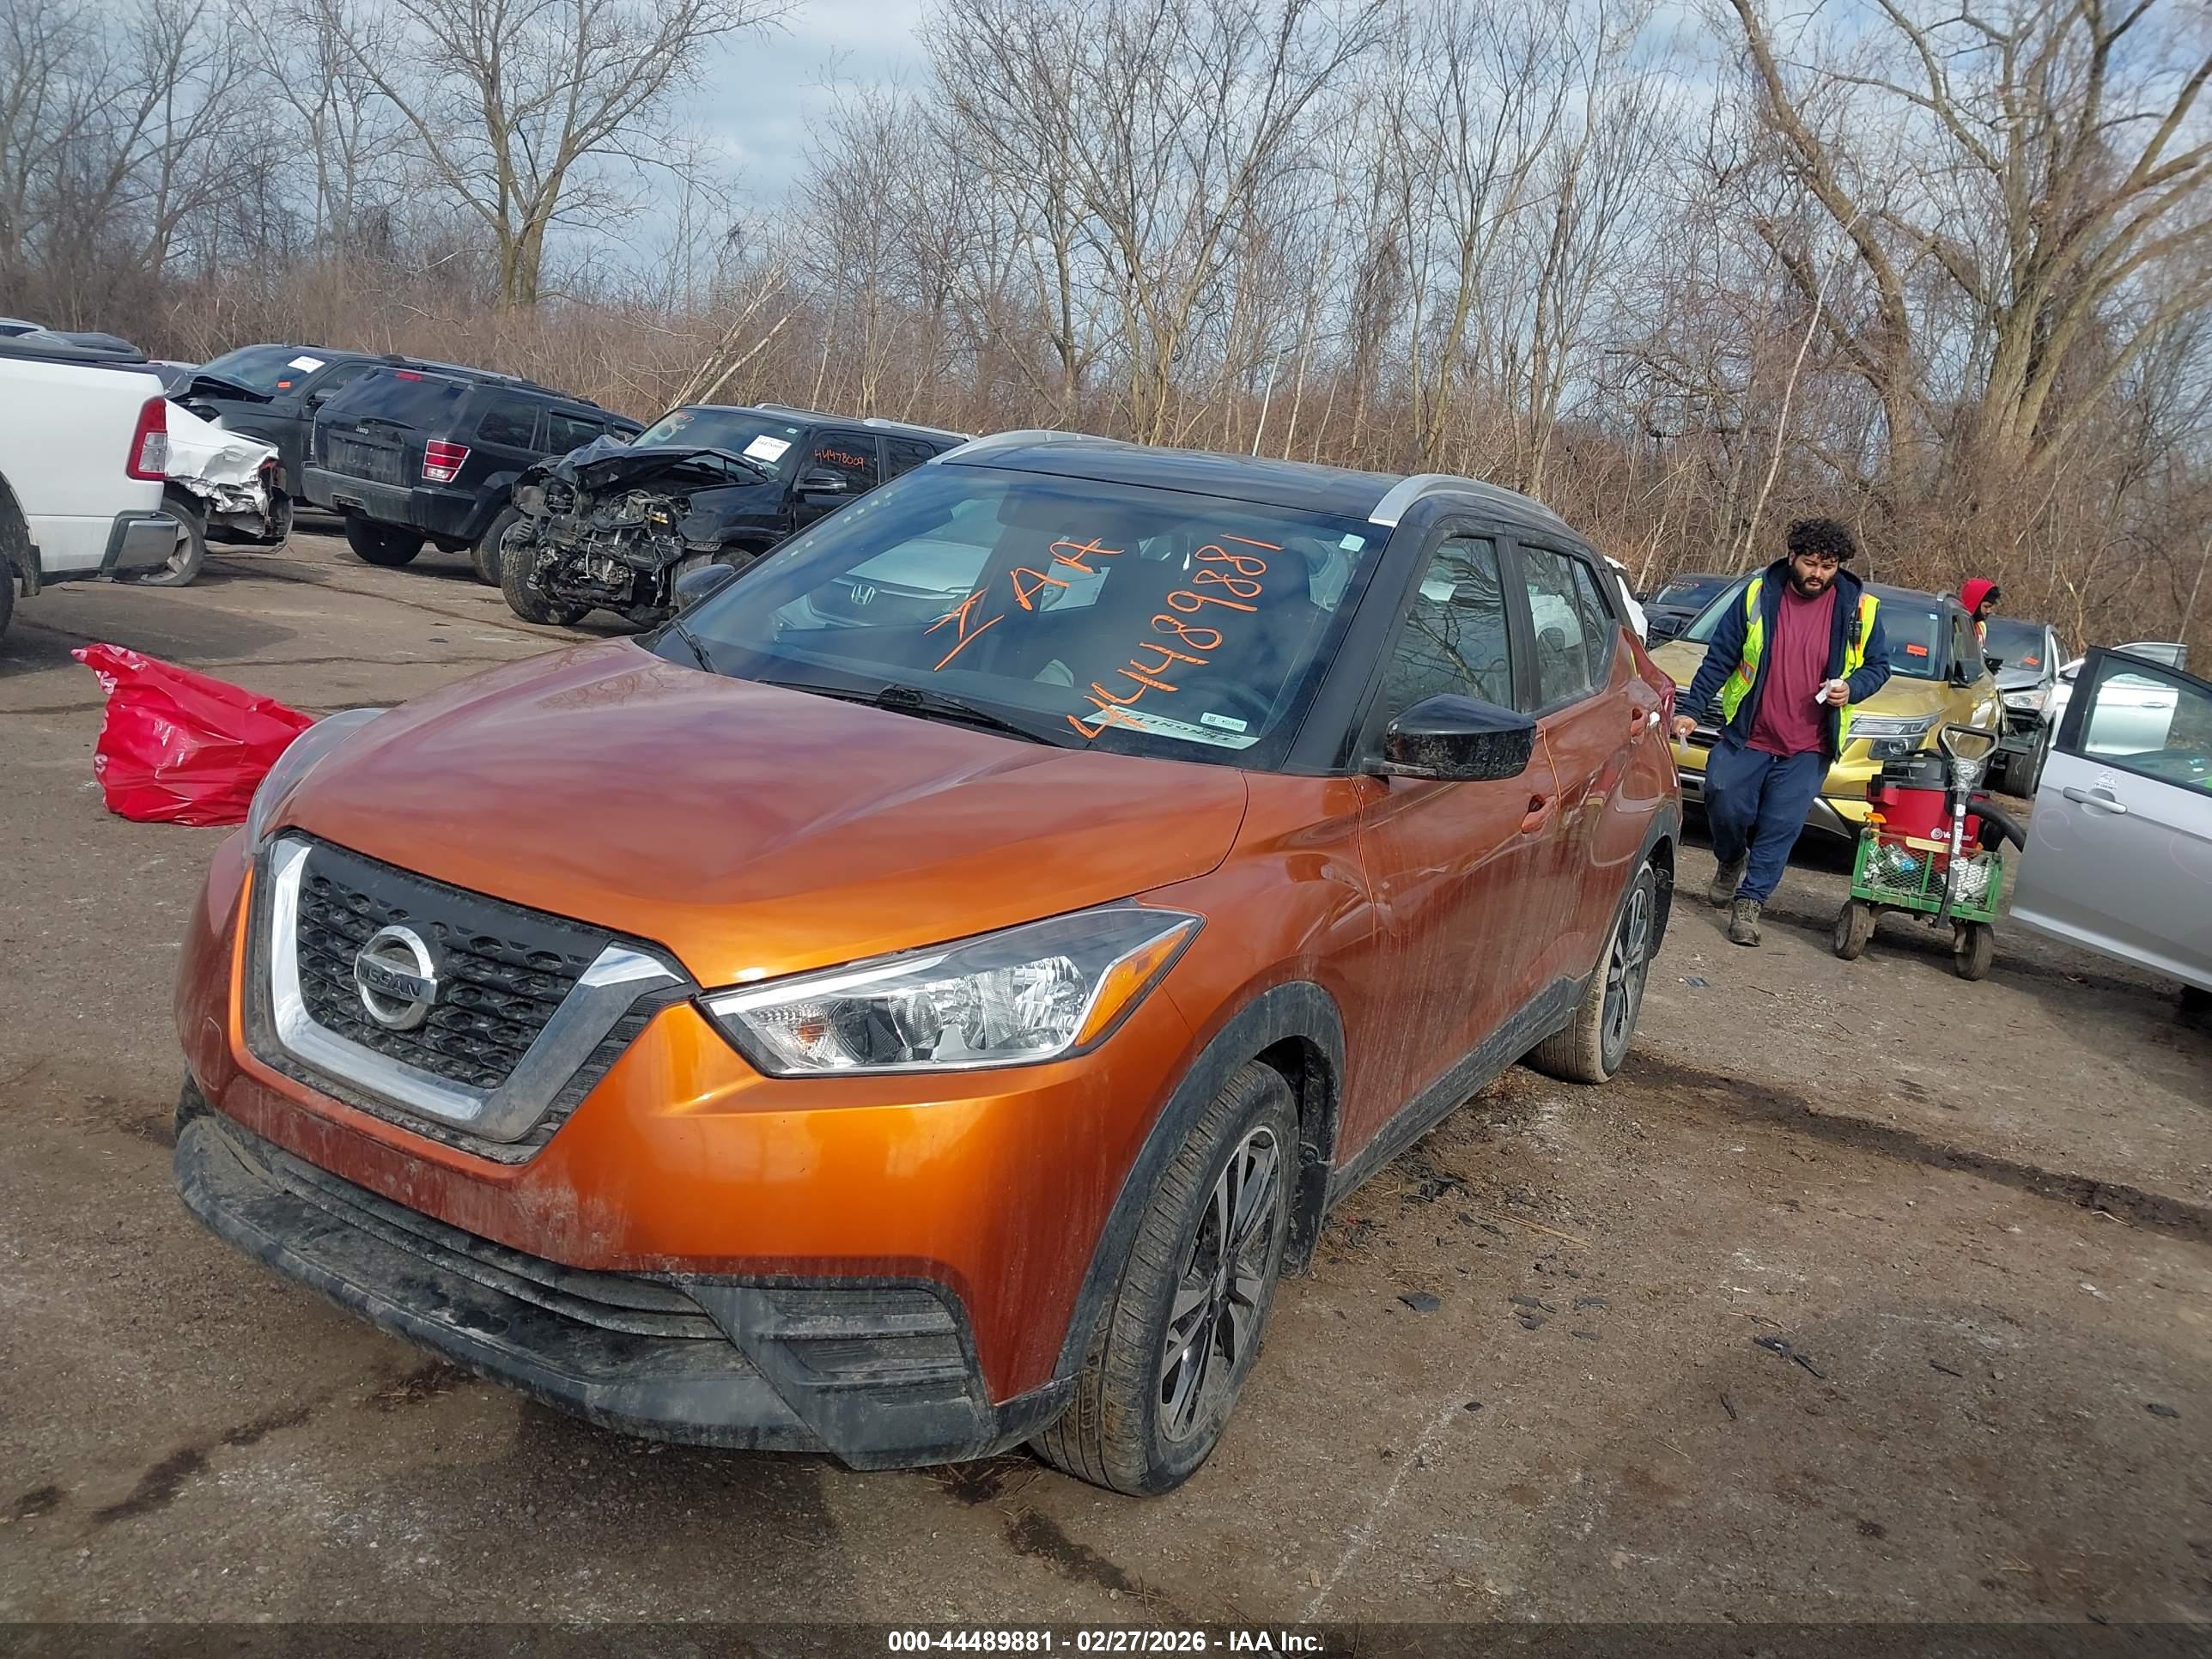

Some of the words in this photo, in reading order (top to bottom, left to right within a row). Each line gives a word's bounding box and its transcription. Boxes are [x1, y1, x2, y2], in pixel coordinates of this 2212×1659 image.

[814, 448, 865, 471] 44478009
[1066, 533, 1285, 738] 44489881
[357, 961, 422, 998] NISSAN
